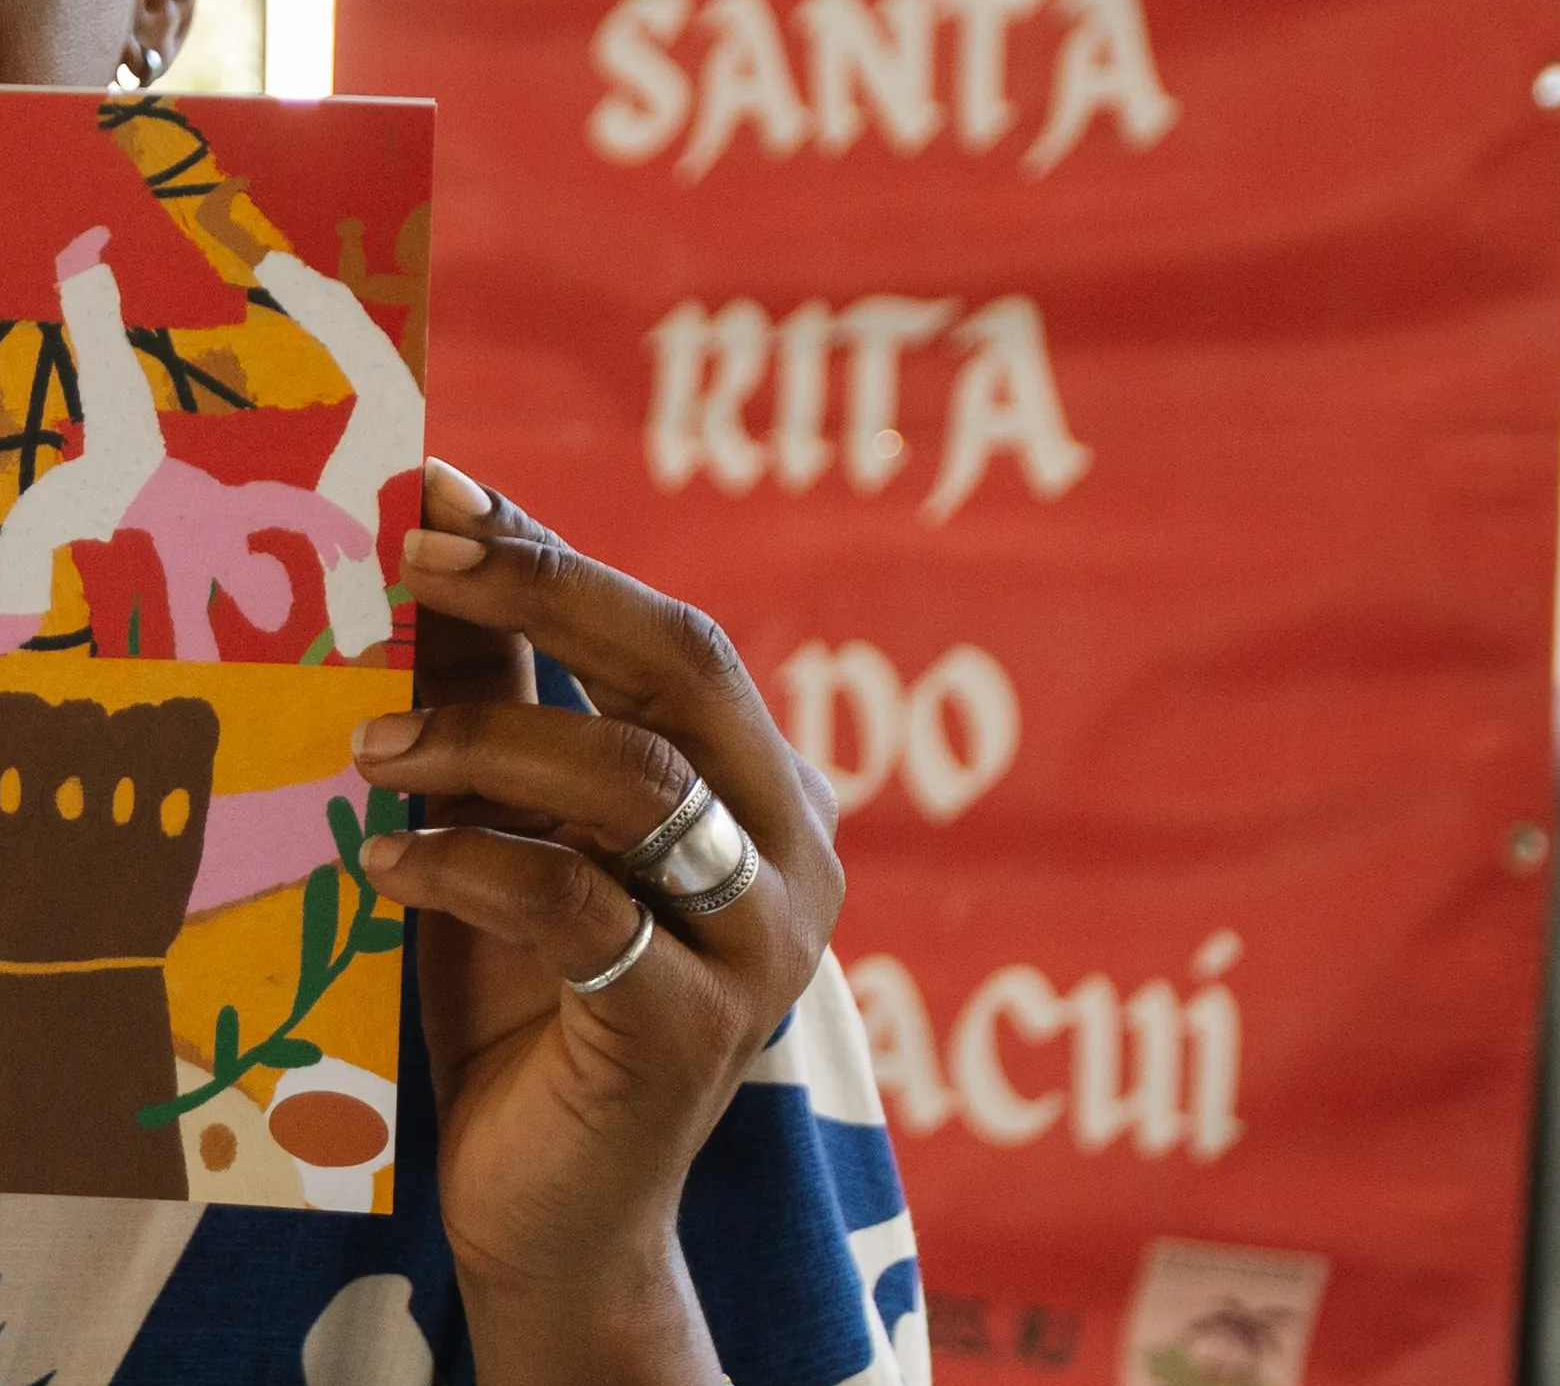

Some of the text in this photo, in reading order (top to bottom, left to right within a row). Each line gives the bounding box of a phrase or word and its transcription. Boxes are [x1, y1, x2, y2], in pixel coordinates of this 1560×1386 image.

[644, 293, 1093, 527] RITA
[775, 637, 1023, 827] DO
[835, 927, 1246, 1165] ACUÍ
